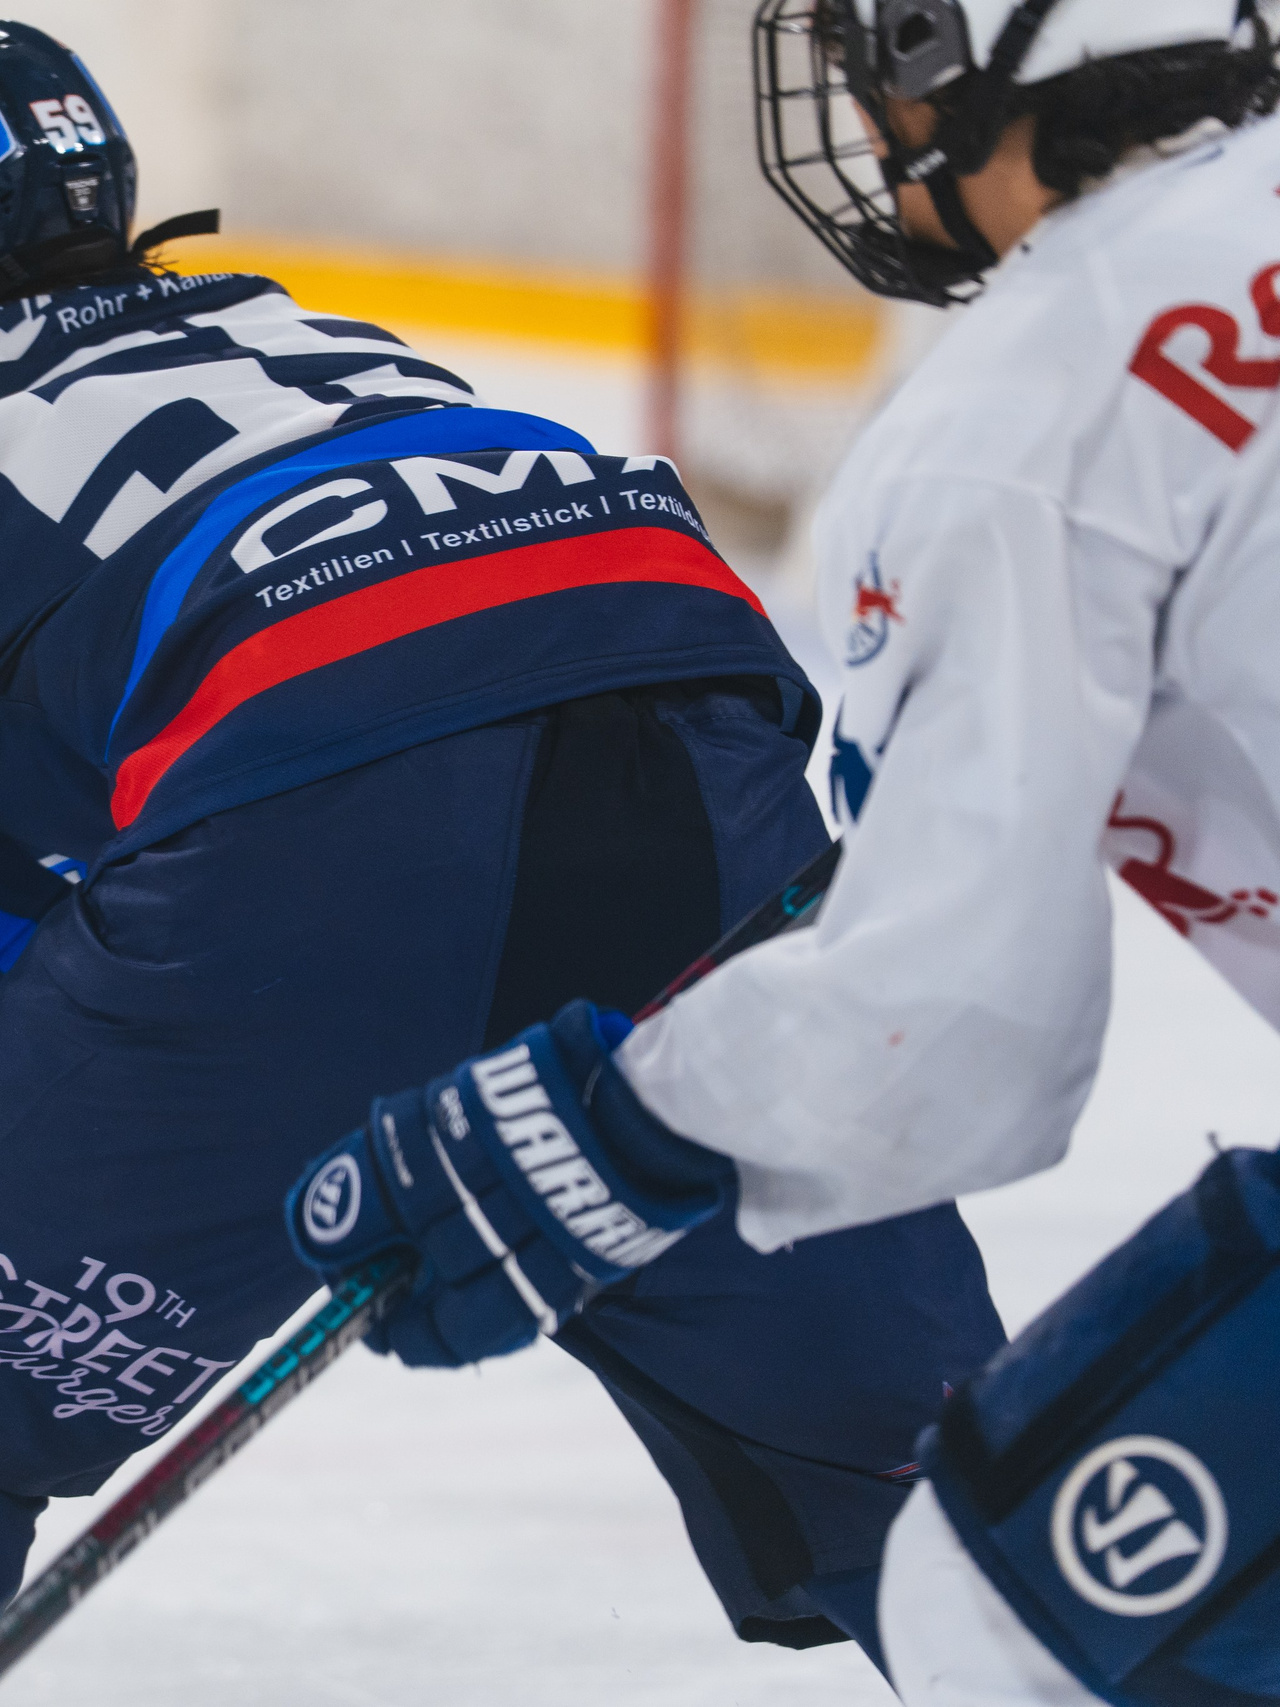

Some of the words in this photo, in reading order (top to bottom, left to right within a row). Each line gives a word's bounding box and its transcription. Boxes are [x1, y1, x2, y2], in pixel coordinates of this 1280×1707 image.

[28, 93, 107, 155] 59
[56, 292, 129, 334] Rohr
[255, 544, 395, 609] Textilien
[420, 501, 594, 552] Textilstick
